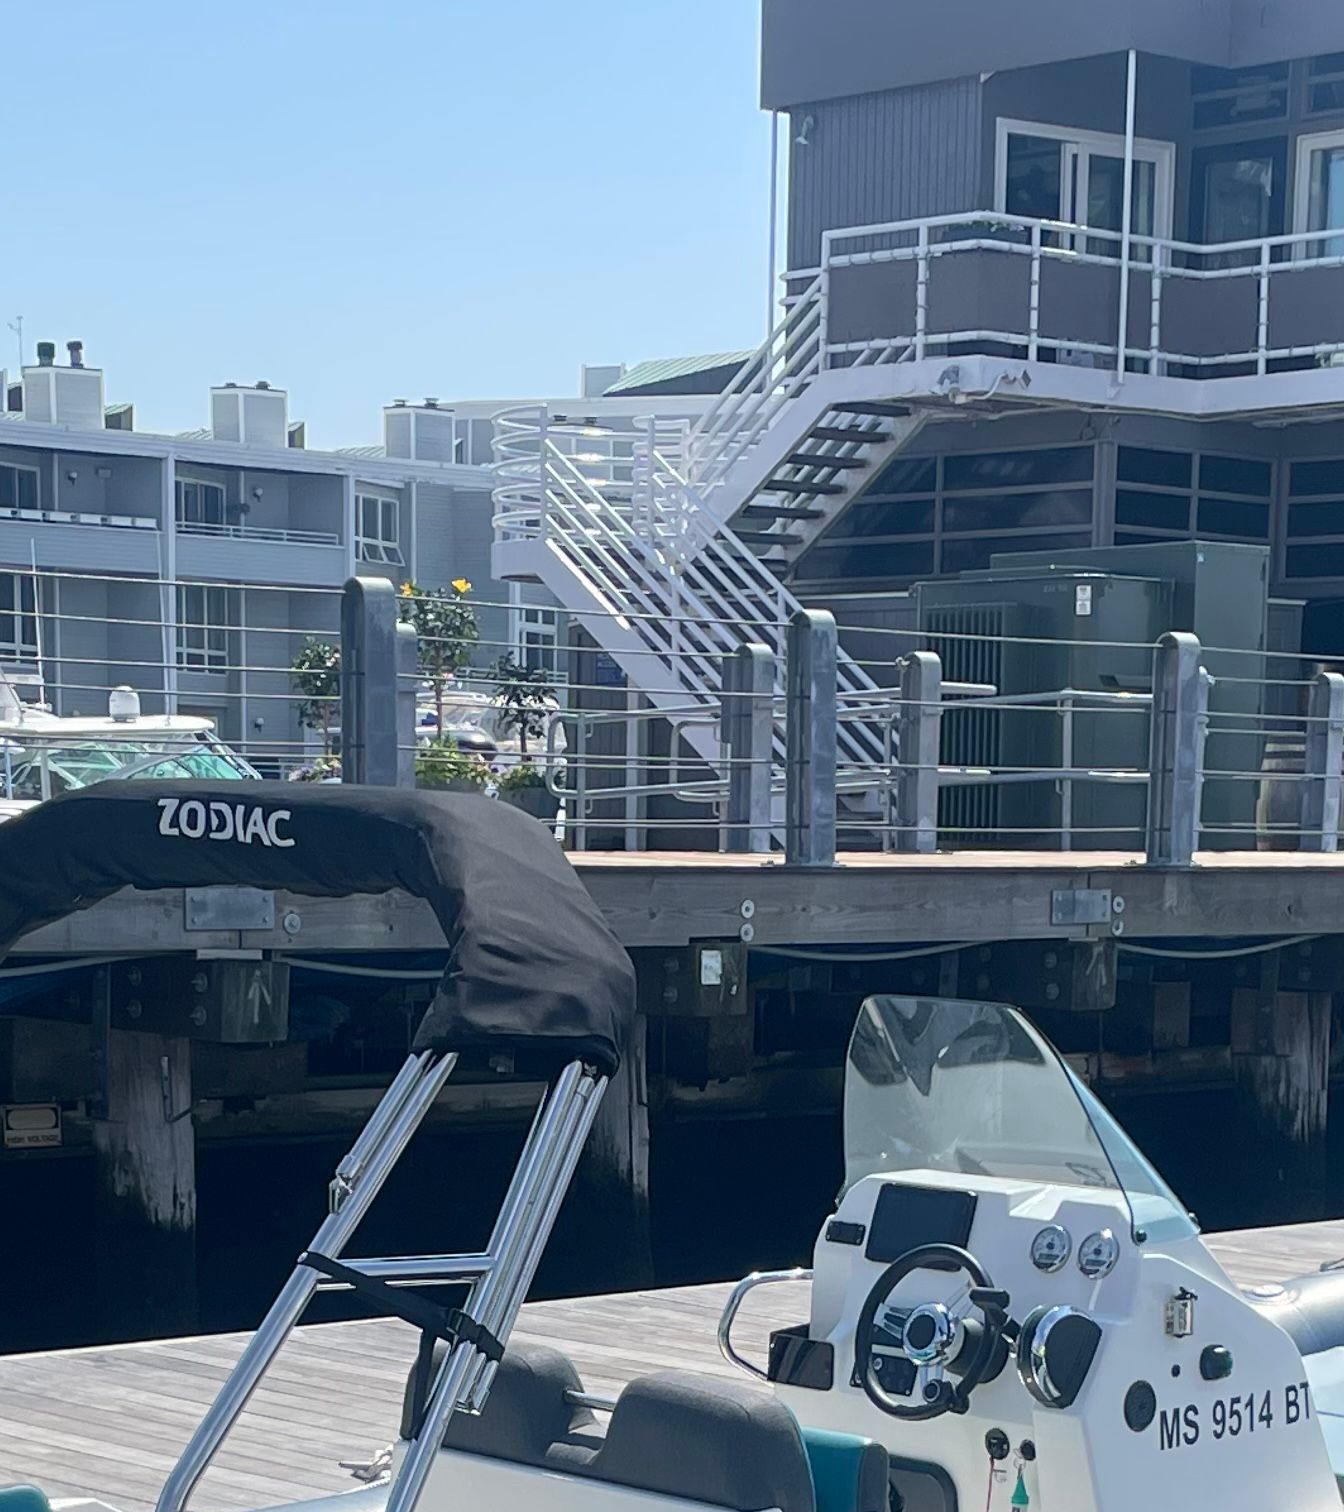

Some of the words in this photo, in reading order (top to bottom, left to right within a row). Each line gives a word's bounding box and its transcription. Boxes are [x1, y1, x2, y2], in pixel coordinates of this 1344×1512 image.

[157, 798, 296, 848] ZODIAC
[1159, 1404, 1200, 1451] MS
[1212, 1389, 1274, 1440] 9514
[1285, 1381, 1311, 1425] BT
